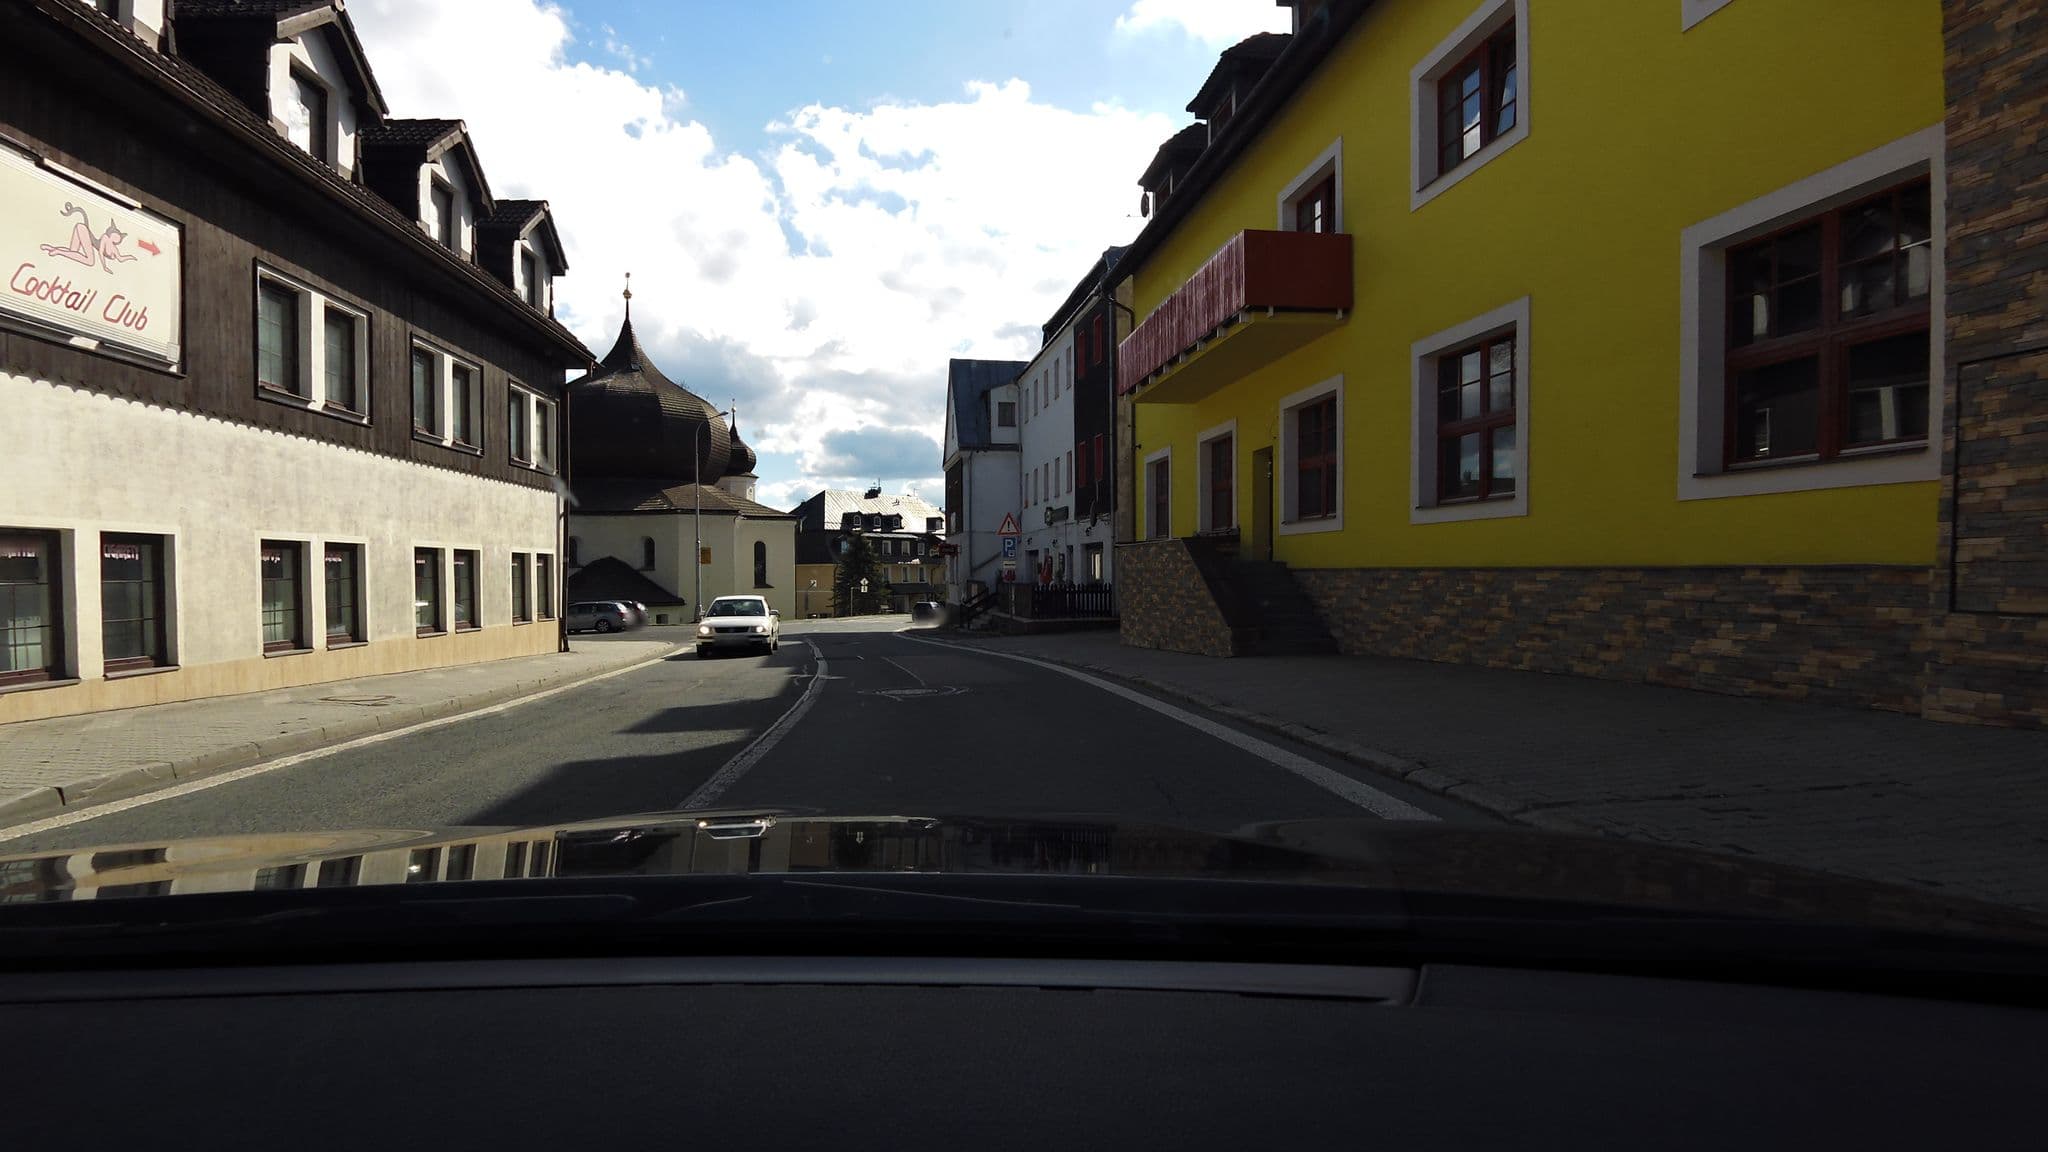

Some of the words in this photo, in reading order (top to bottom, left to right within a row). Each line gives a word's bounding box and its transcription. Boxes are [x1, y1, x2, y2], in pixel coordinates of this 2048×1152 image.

[10, 262, 98, 314] Cocktail
[103, 294, 148, 331] Club
[1005, 539, 1013, 552] P
